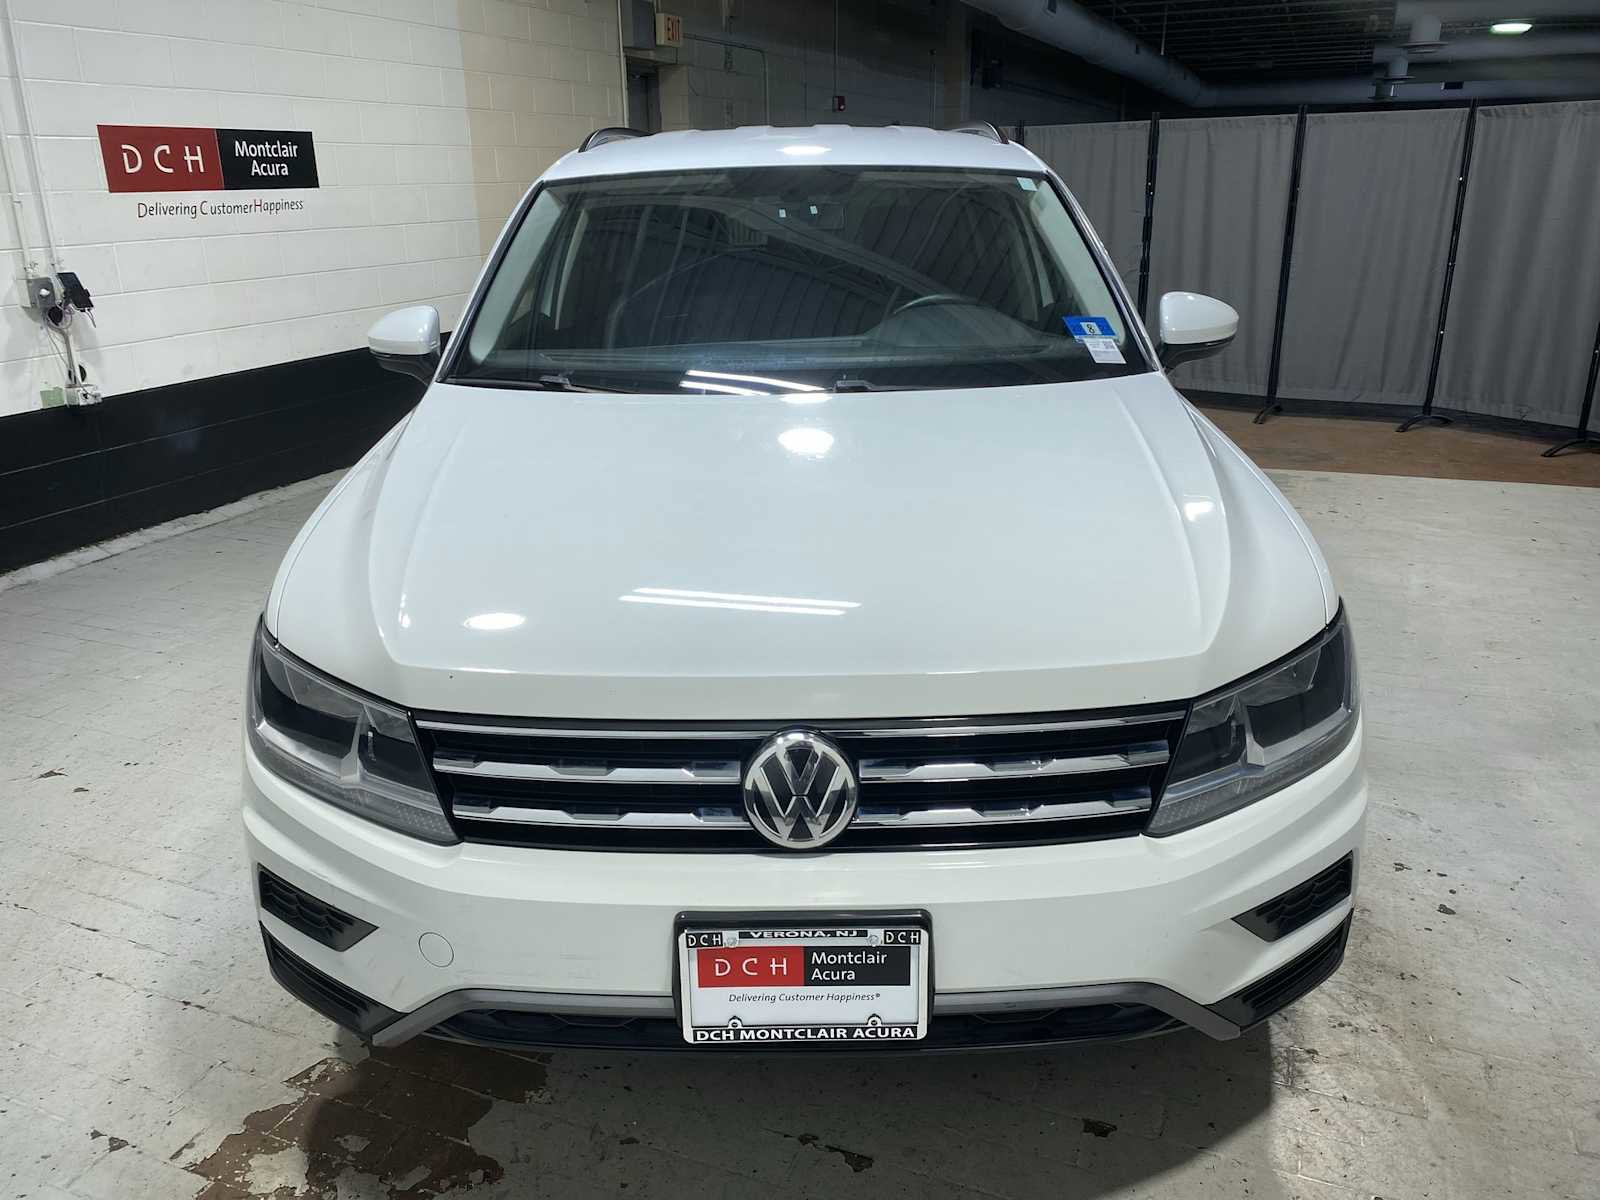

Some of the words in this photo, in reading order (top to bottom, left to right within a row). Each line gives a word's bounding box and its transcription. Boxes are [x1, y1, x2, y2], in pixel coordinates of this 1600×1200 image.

[667, 16, 680, 41] EXIT
[234, 140, 299, 158] Montclair
[250, 160, 289, 177] Acura
[137, 202, 197, 219] Delivering
[688, 934, 722, 947] DCH
[885, 932, 921, 944] DCH
[811, 951, 888, 965] Montclair
[811, 967, 856, 981] Acura
[728, 993, 777, 1003] Delivering
[778, 993, 825, 1002] Customer
[696, 1030, 735, 1042] DCH
[739, 1028, 848, 1041] MONTCLAIR
[852, 1027, 915, 1039] ACURA
